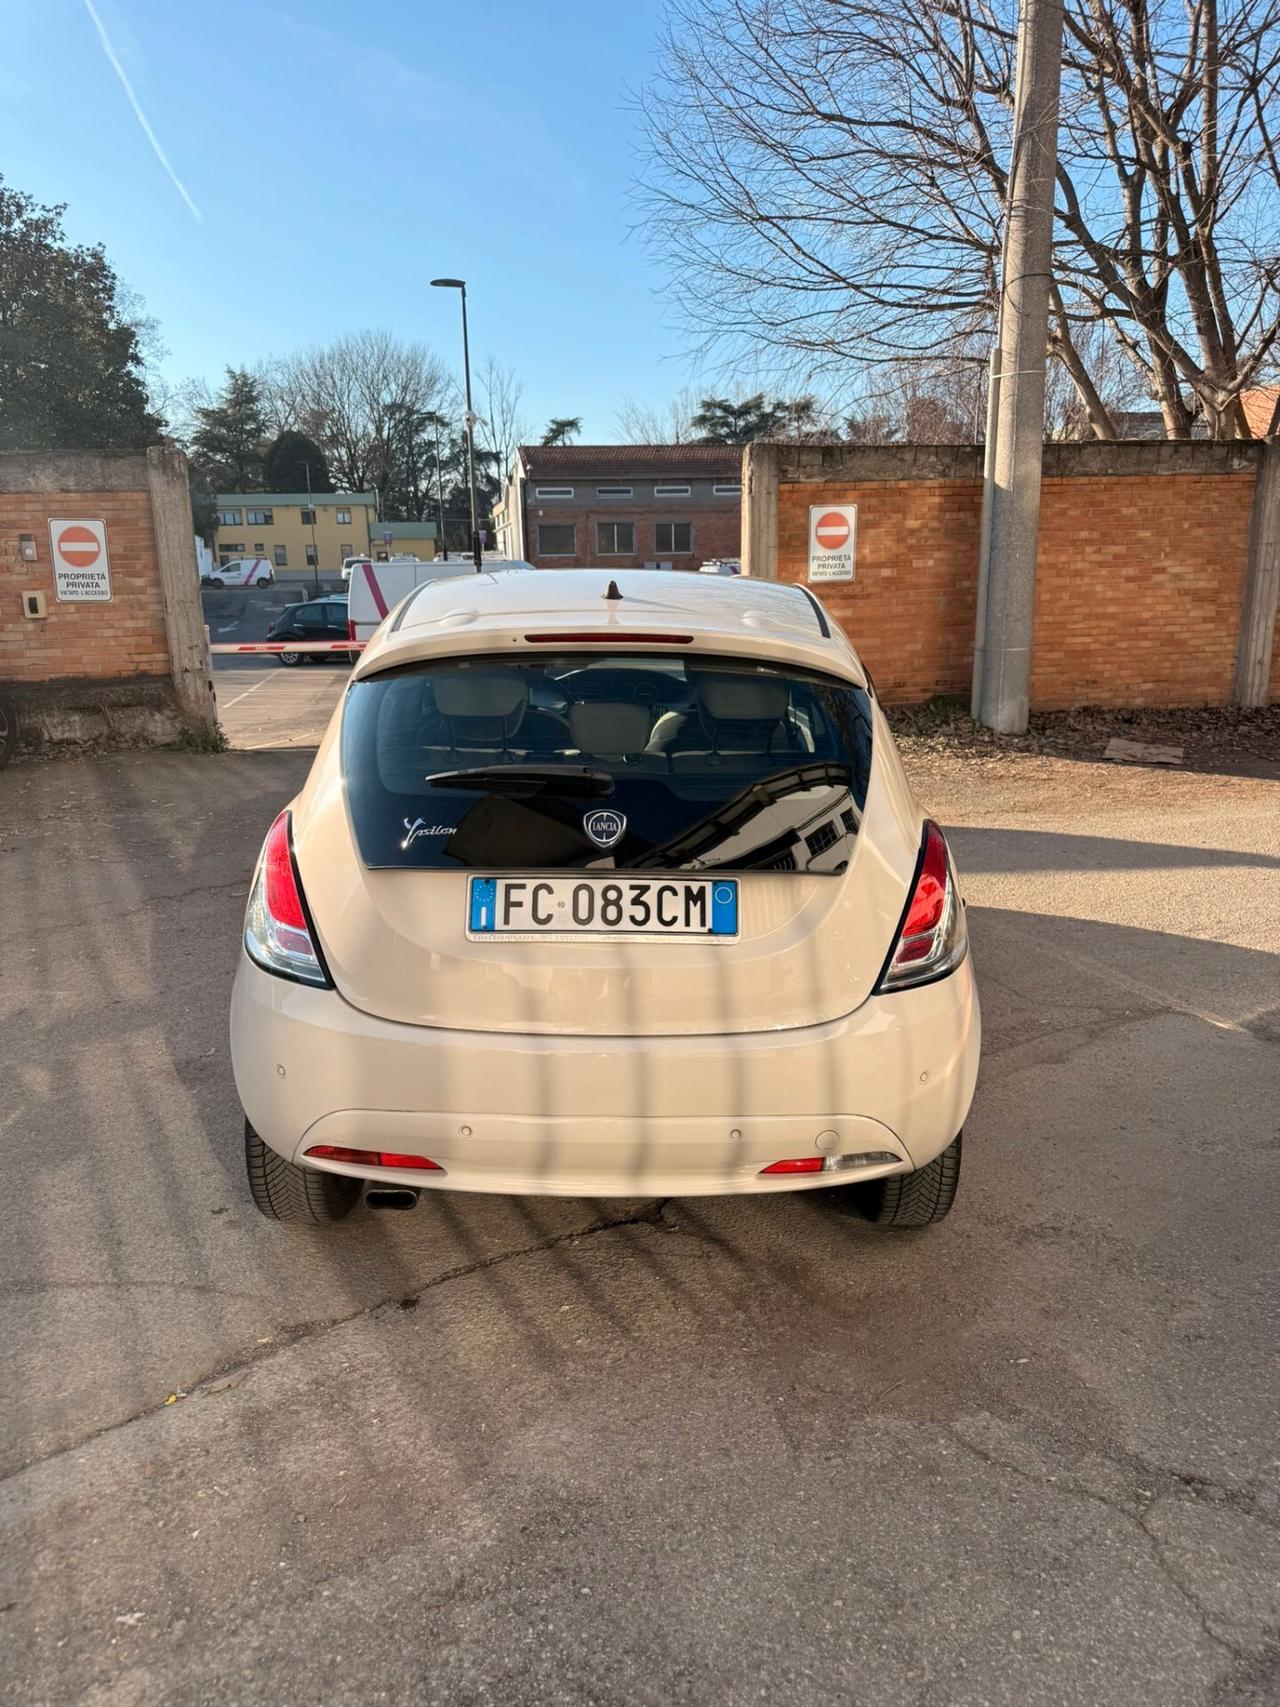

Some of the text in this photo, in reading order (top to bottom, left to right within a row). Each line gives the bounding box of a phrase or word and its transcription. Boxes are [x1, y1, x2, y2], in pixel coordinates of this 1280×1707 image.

[400, 816, 459, 850] Ypsilon
[592, 821, 618, 833] LANCIA
[503, 882, 707, 928] FC 083CM
